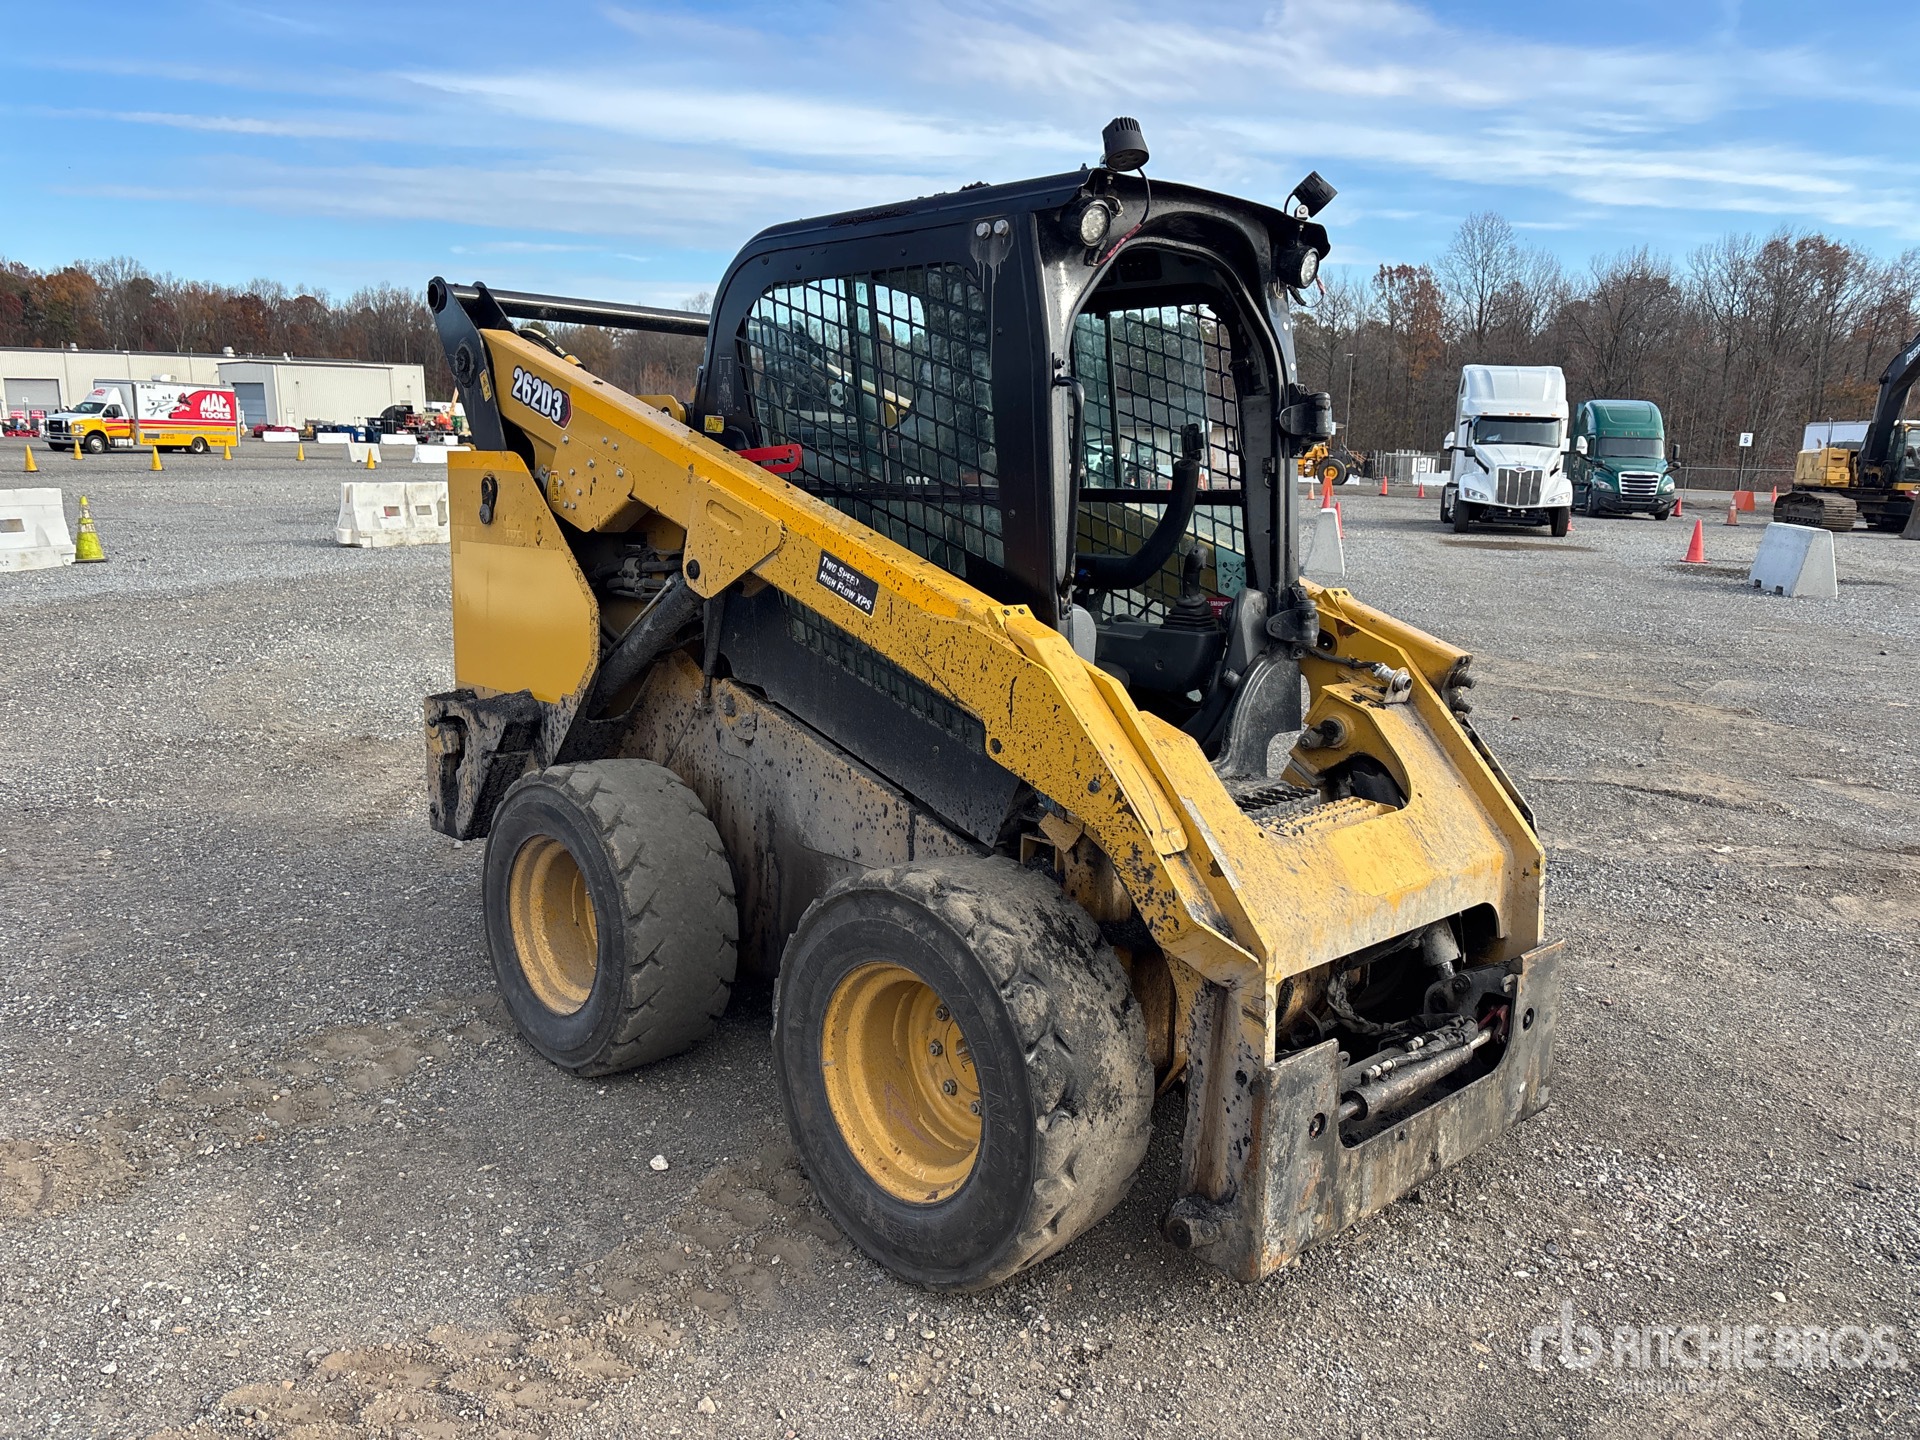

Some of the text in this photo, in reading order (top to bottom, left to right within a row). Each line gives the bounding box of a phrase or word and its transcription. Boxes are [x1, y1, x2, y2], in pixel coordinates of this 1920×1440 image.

[200, 393, 231, 412] MAC
[511, 366, 564, 423] 262D3
[200, 411, 232, 420] TOOLS
[819, 570, 872, 610] HIGH FLOW XPS
